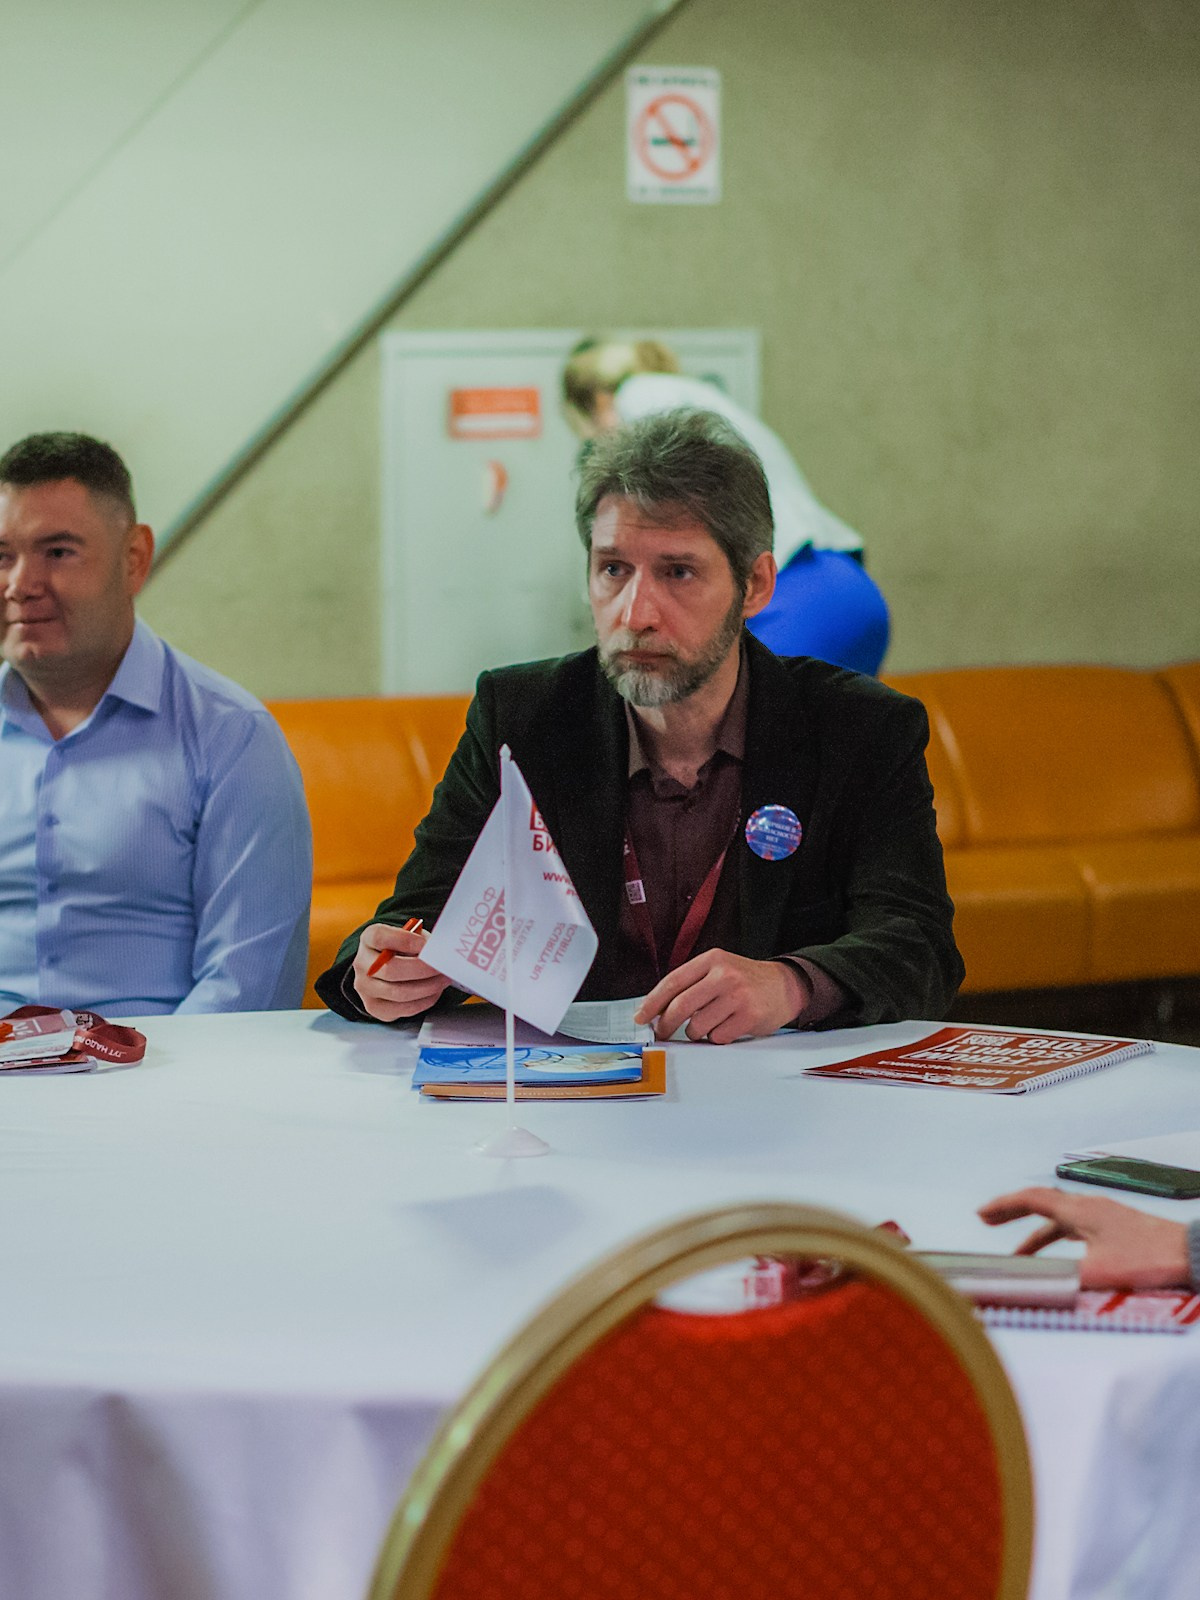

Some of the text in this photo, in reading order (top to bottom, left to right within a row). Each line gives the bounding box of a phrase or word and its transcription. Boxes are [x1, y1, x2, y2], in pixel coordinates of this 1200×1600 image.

[85, 1038, 108, 1054] НАДО
[933, 1044, 1084, 1059] SECURITY
[1019, 1038, 1104, 1052] 2018
[908, 1051, 1031, 1065] FORUM
